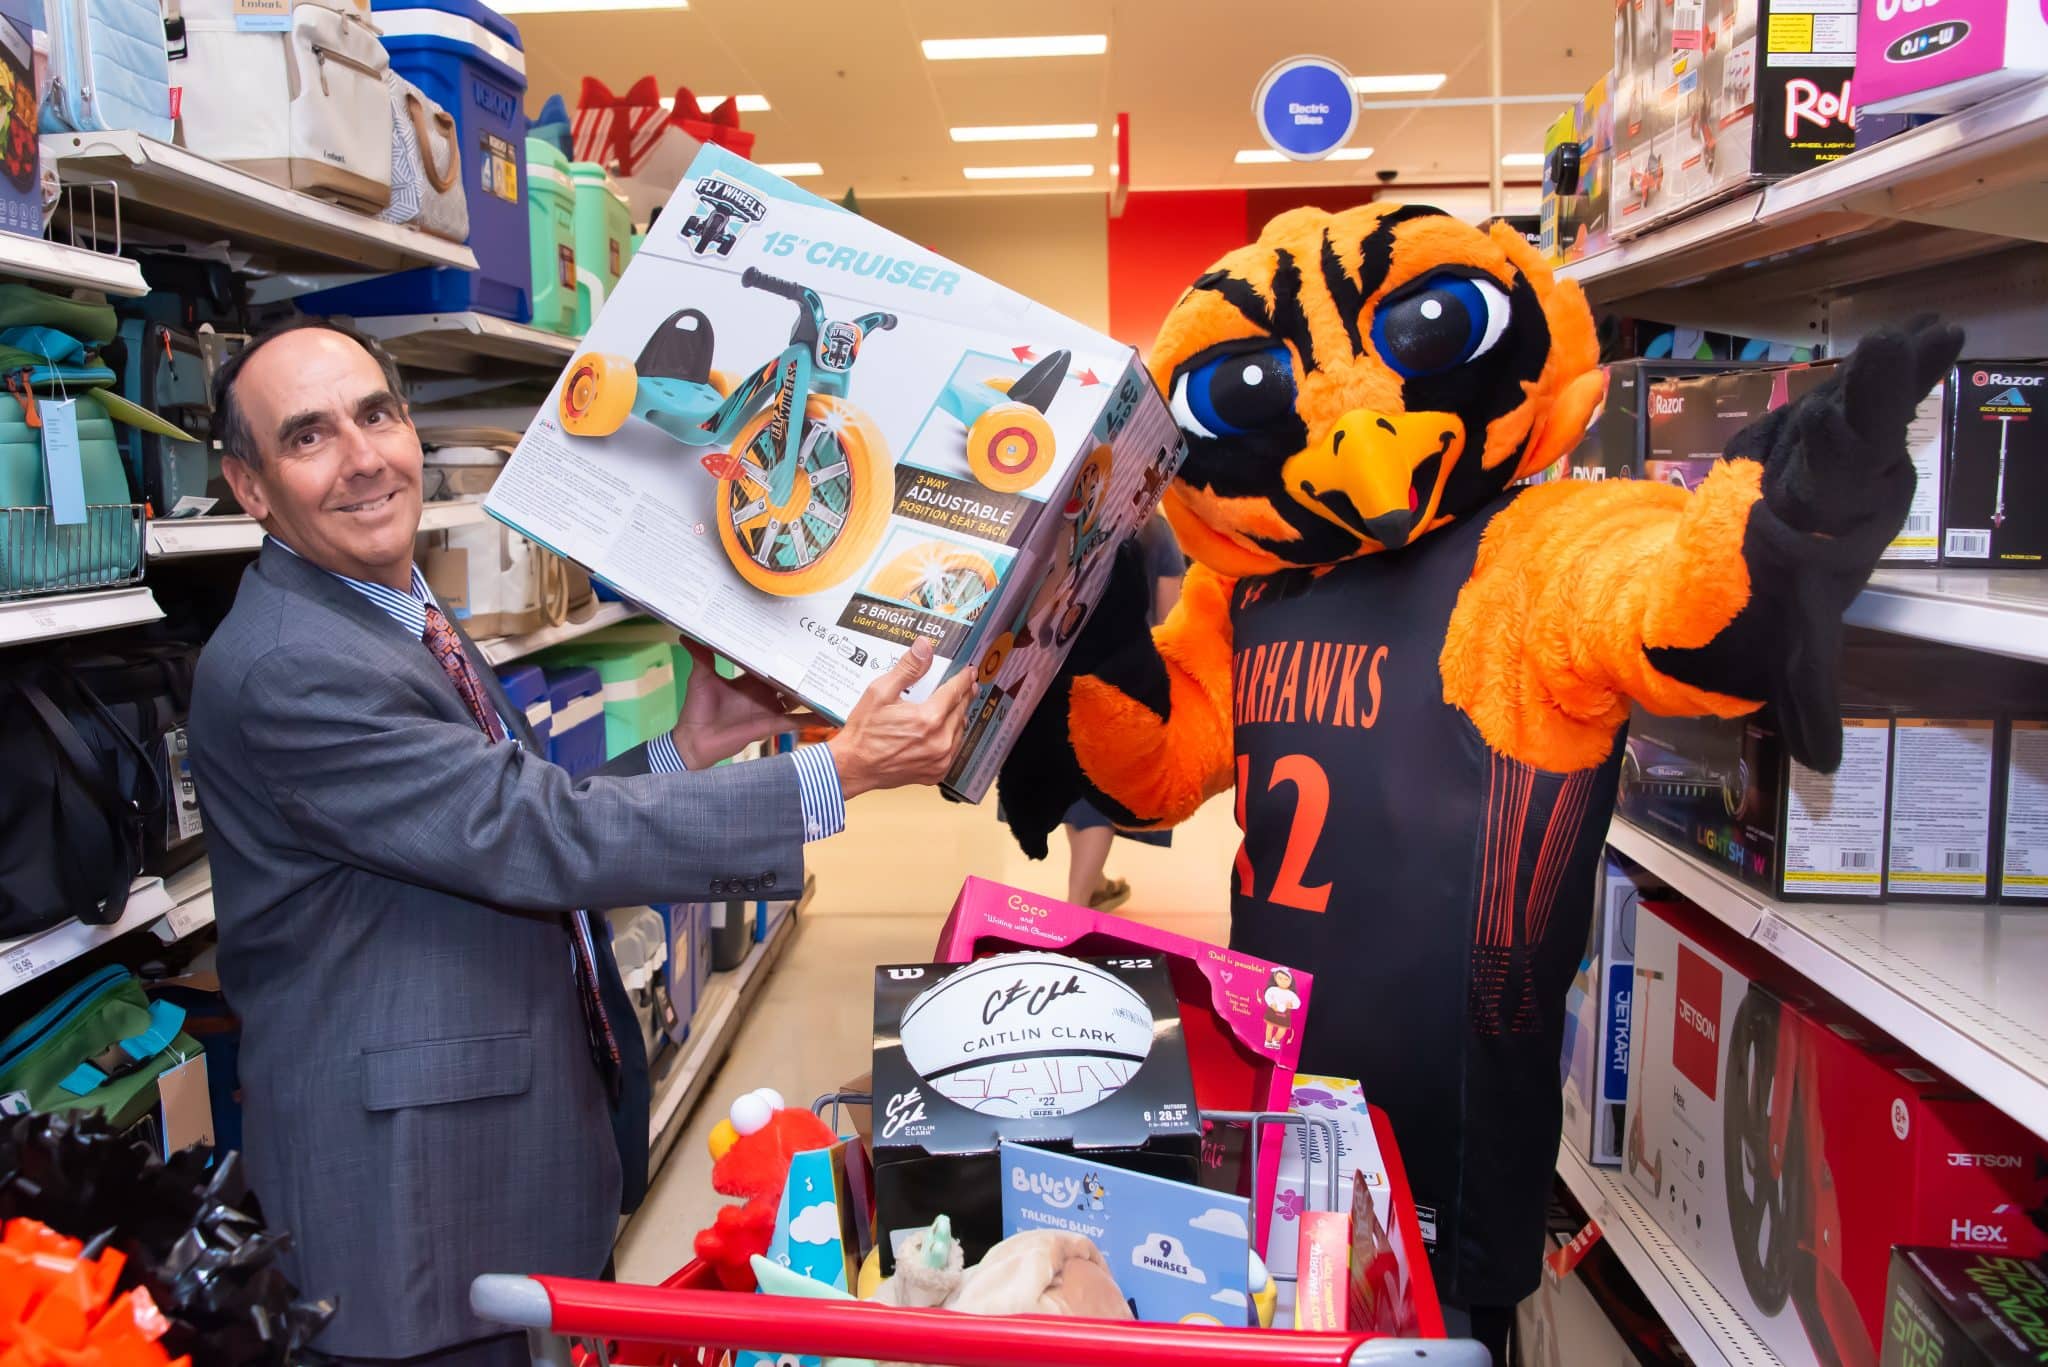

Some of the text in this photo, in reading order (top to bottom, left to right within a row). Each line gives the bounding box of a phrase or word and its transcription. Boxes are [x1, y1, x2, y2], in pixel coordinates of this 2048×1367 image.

[1288, 102, 1330, 114] Electric
[698, 179, 765, 219] FLY WHEELS
[1990, 373, 2045, 386] Razor
[1656, 395, 1684, 414] Razor
[917, 475, 949, 490] 3-WAY
[906, 485, 1014, 525] ADJUSTABLE
[899, 500, 1008, 537] POSITION SEAT BACK
[853, 615, 876, 629] LIGHT
[876, 621, 889, 633] UP
[888, 625, 900, 636] AS
[901, 628, 918, 641] YOU
[858, 603, 946, 638] 2 BRIGHT LEDs
[1007, 894, 1048, 918] Coco
[1014, 924, 1030, 933] with
[1020, 916, 1034, 924] and
[1208, 950, 1226, 963] Doll
[1613, 990, 1632, 1075] JETKART
[1679, 998, 1716, 1043] JETSON
[963, 1026, 1118, 1053] CAITLIN CLARK
[1947, 1153, 2022, 1168] JETSON
[1020, 1207, 1105, 1238] TALKING BLUEY
[1951, 1218, 2008, 1242] Hex.
[1160, 1239, 1172, 1258] 9
[1143, 1255, 1188, 1275] PHRASES
[1891, 1299, 1944, 1366] SIDE
